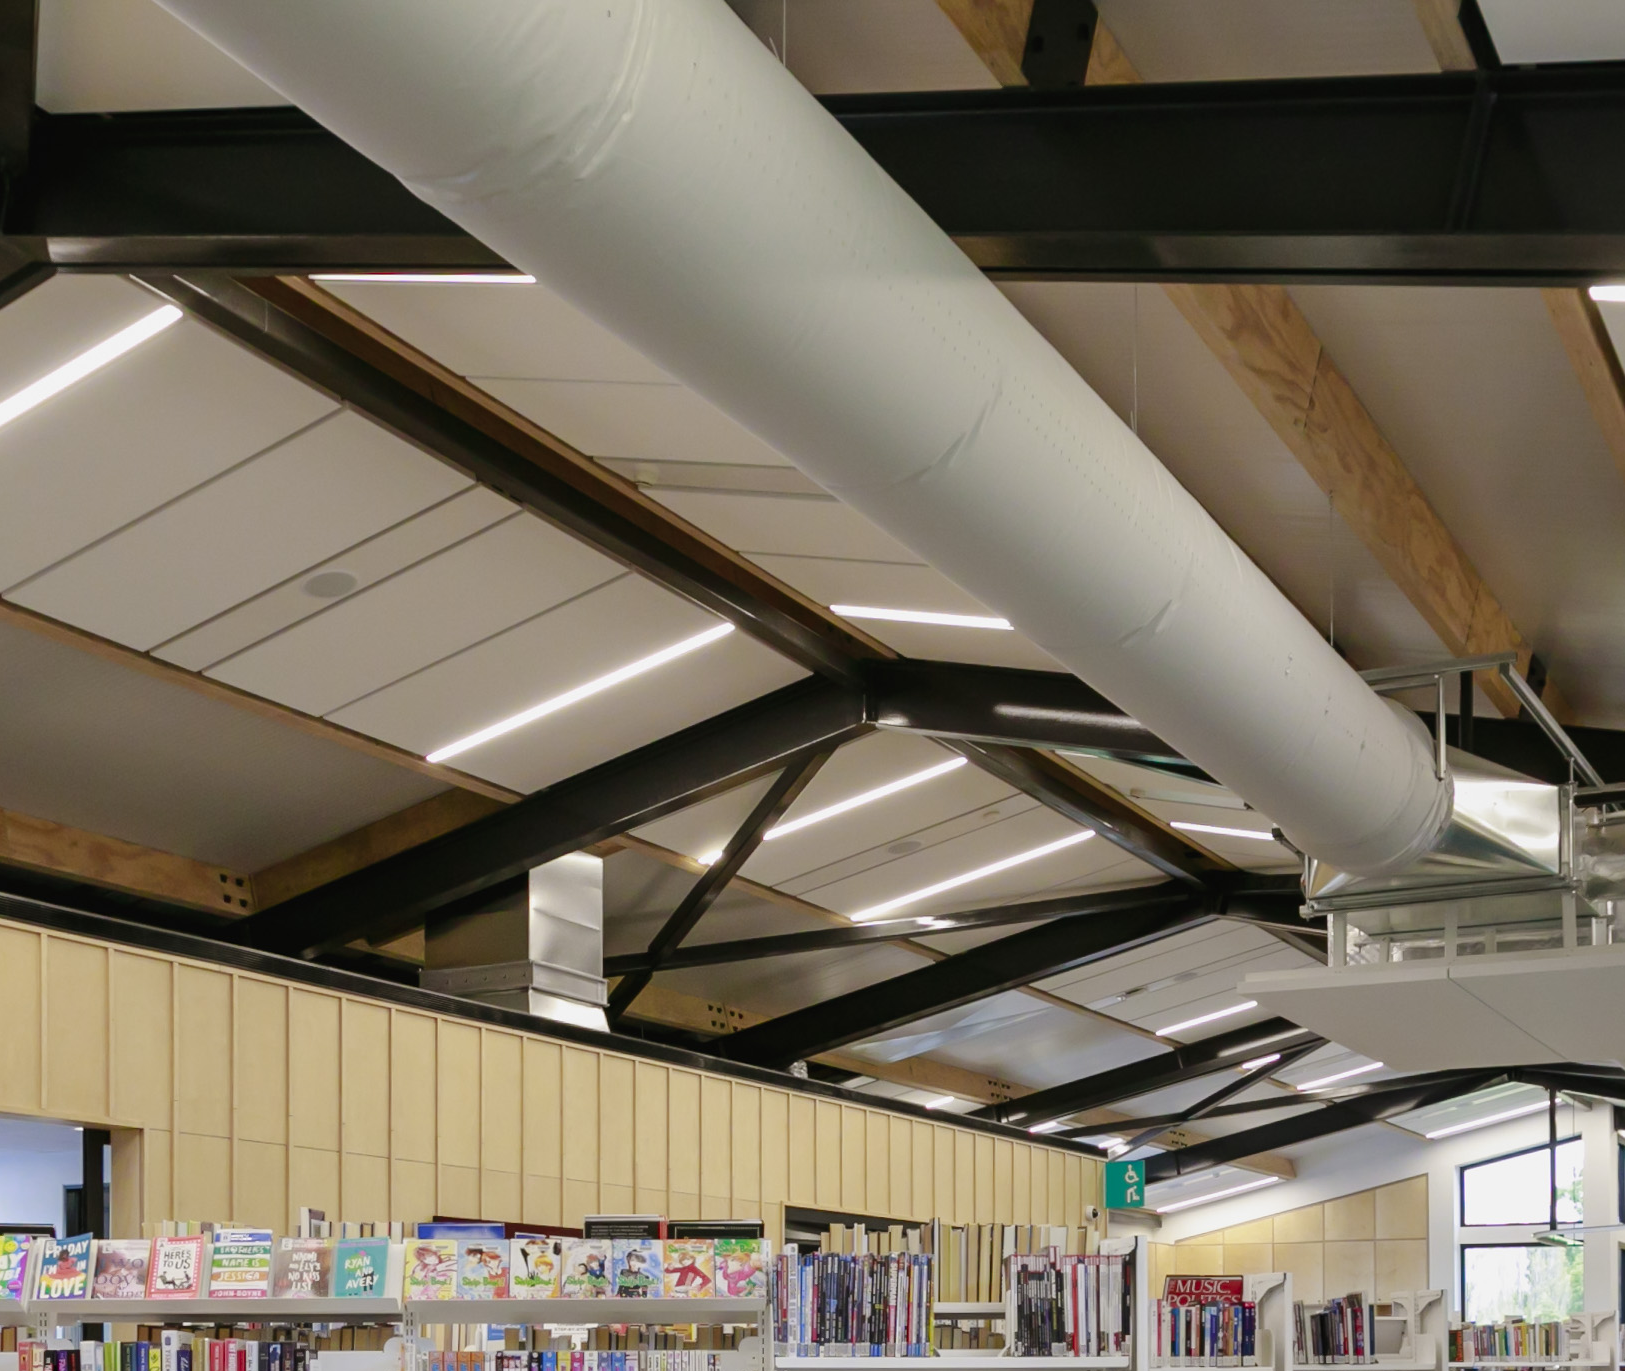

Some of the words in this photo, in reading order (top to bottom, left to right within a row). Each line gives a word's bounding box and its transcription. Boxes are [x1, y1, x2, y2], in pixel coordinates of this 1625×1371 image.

[77, 1261, 86, 1270] IN
[164, 1259, 174, 1267] TO
[175, 1258, 190, 1269] US
[345, 1256, 371, 1270] RYAN
[303, 1272, 320, 1281] KISS
[292, 1281, 313, 1290] LIST
[345, 1275, 378, 1290] AVERY
[40, 1280, 84, 1299] LOVE
